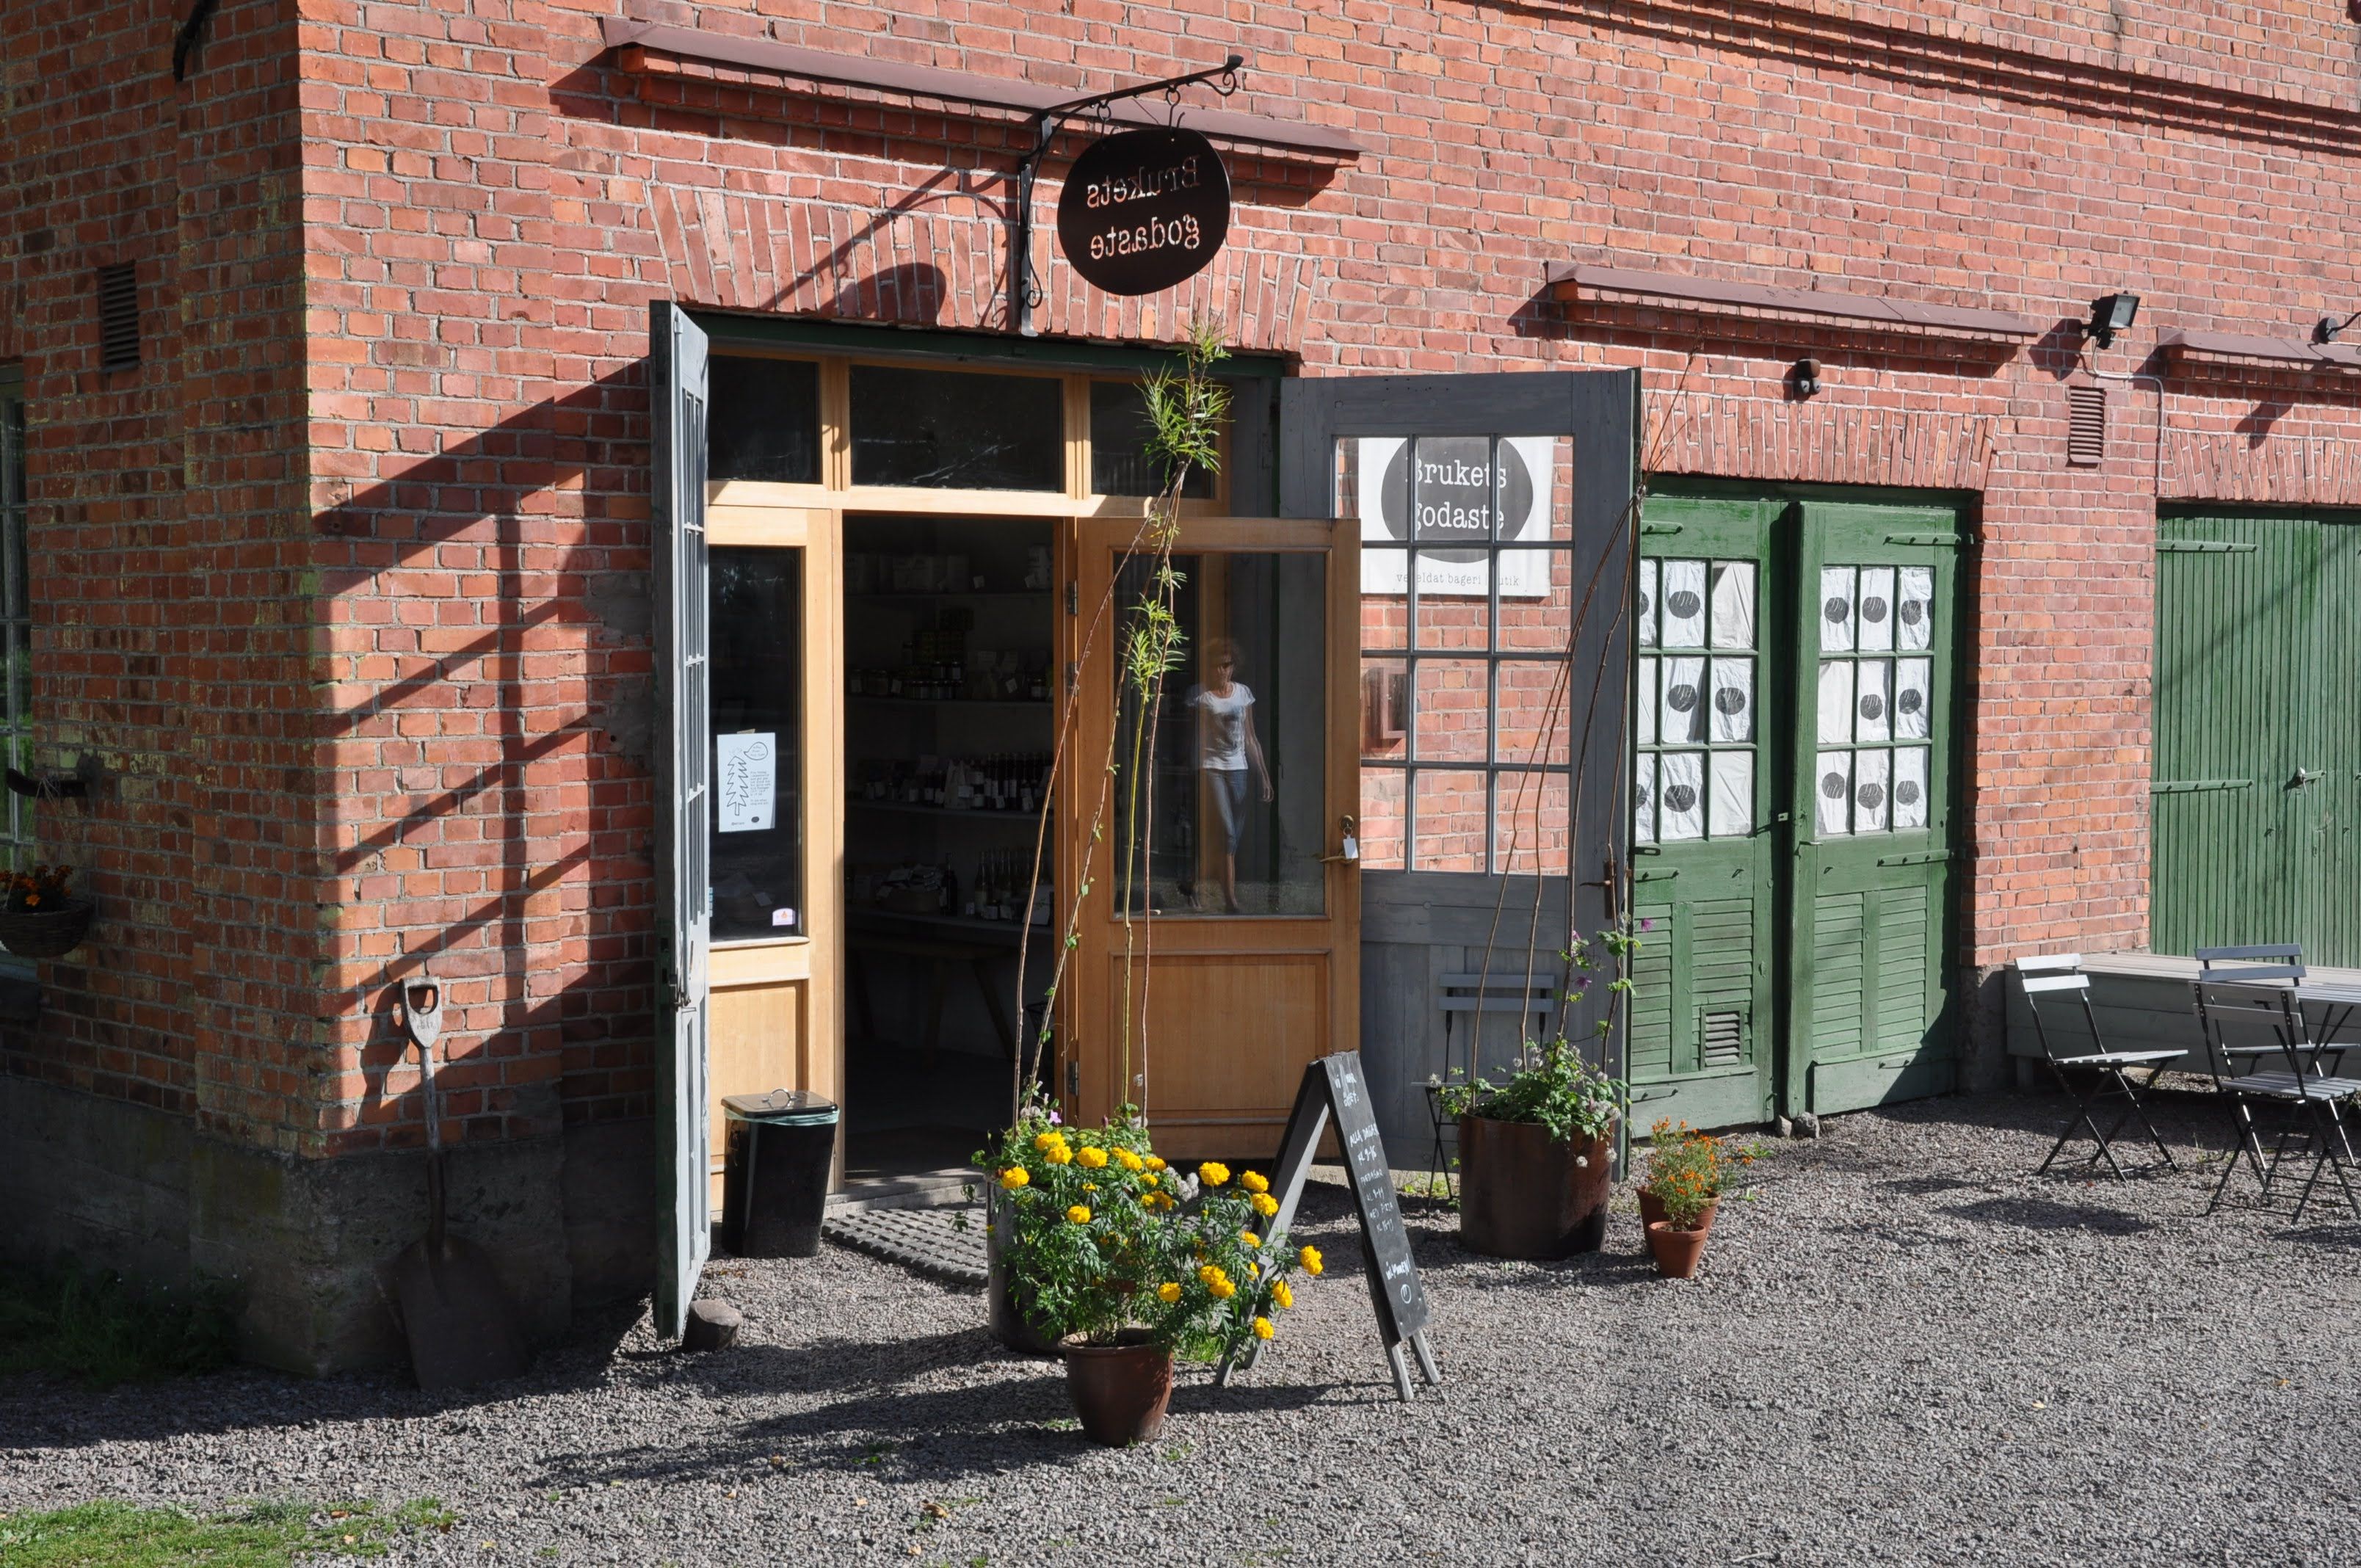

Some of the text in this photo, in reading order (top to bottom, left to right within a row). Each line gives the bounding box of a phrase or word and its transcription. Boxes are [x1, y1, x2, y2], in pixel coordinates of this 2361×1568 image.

[1396, 573, 1519, 587] veeldat bageri utik
